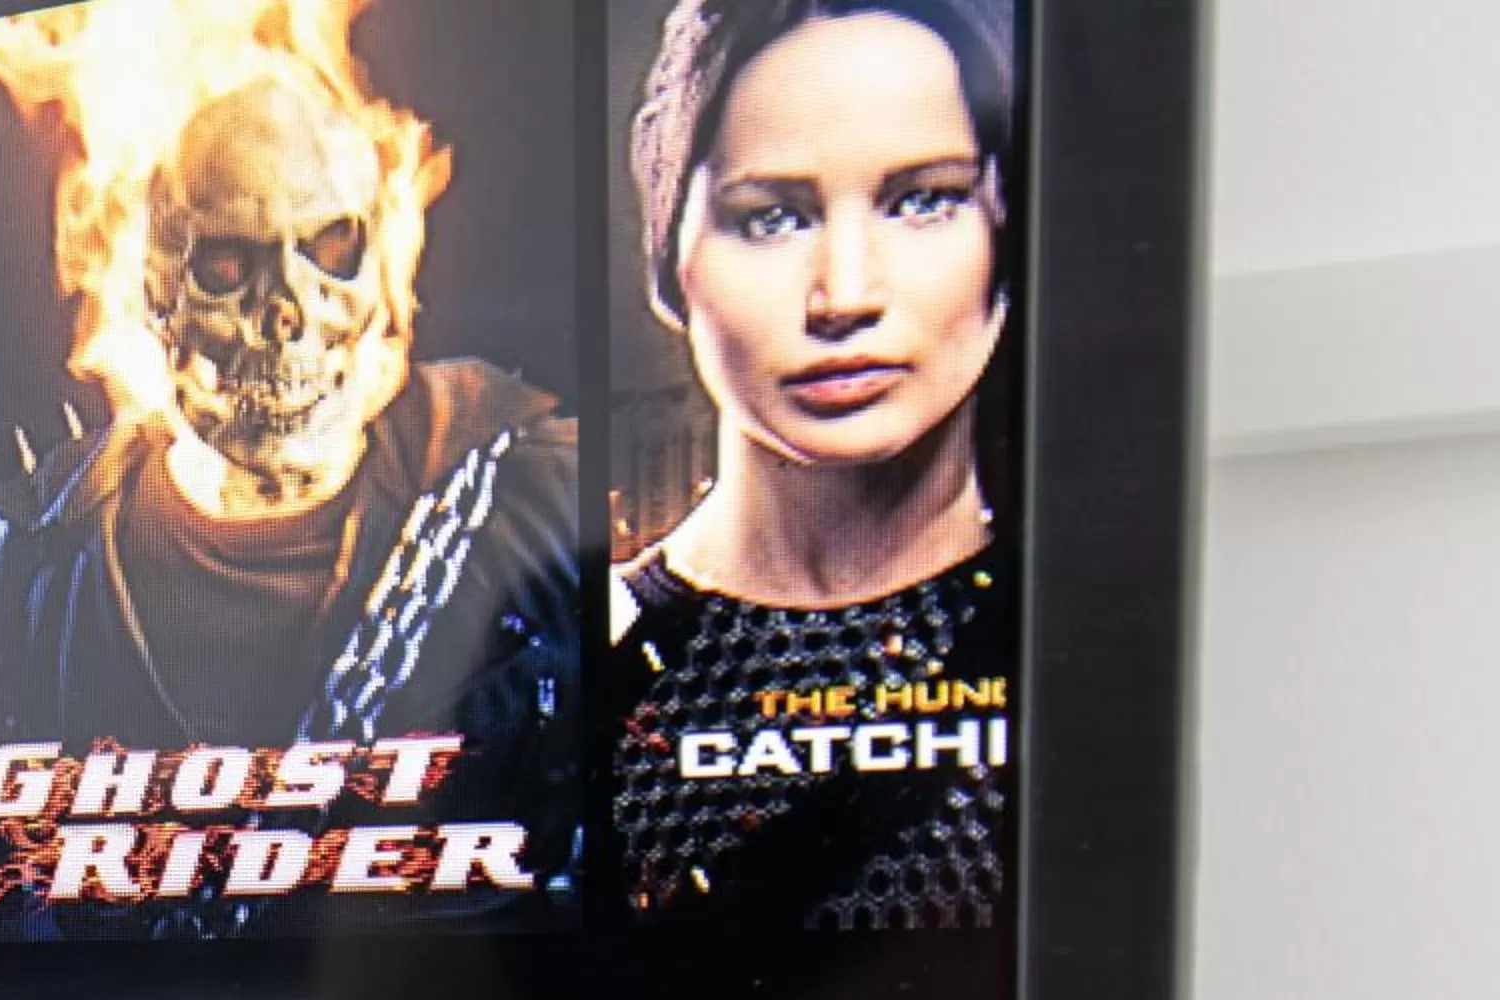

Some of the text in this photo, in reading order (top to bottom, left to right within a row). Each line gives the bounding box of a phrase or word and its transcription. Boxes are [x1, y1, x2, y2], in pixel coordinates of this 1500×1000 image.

[752, 684, 858, 718] THE
[679, 717, 1008, 778] CATCHI
[46, 820, 534, 900] RIDER
